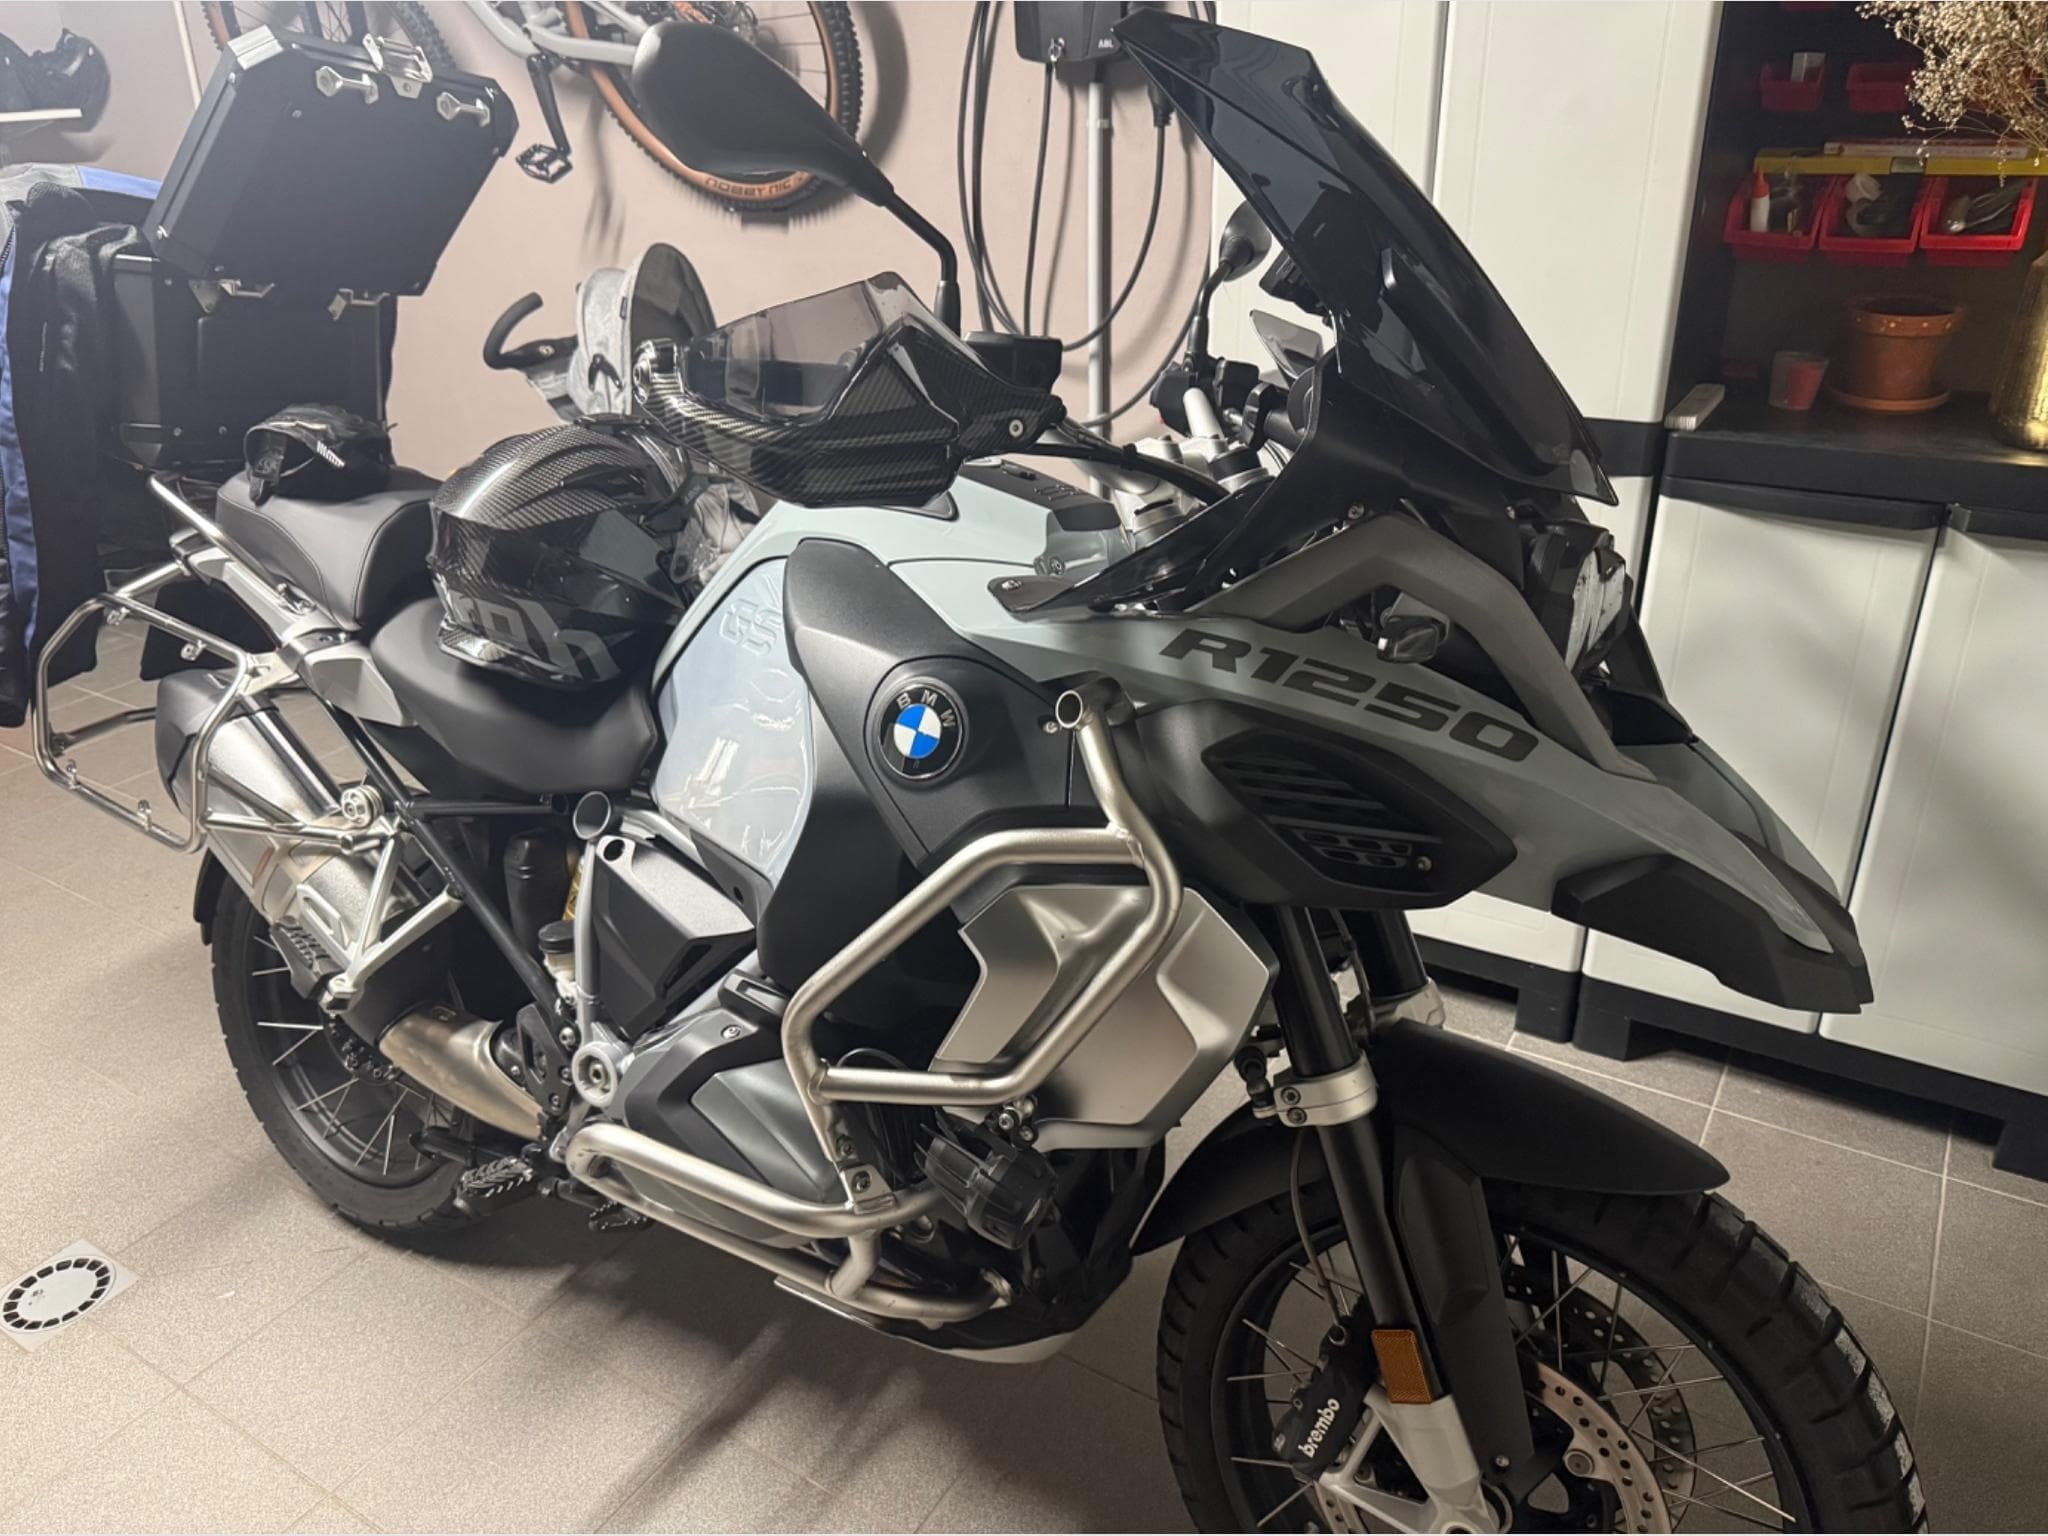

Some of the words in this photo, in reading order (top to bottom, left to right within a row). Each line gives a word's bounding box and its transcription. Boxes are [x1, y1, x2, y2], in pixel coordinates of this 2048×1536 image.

[896, 689, 956, 727] BMW
[1159, 628, 1540, 763] R1250
[1297, 1398, 1341, 1458] brembo
